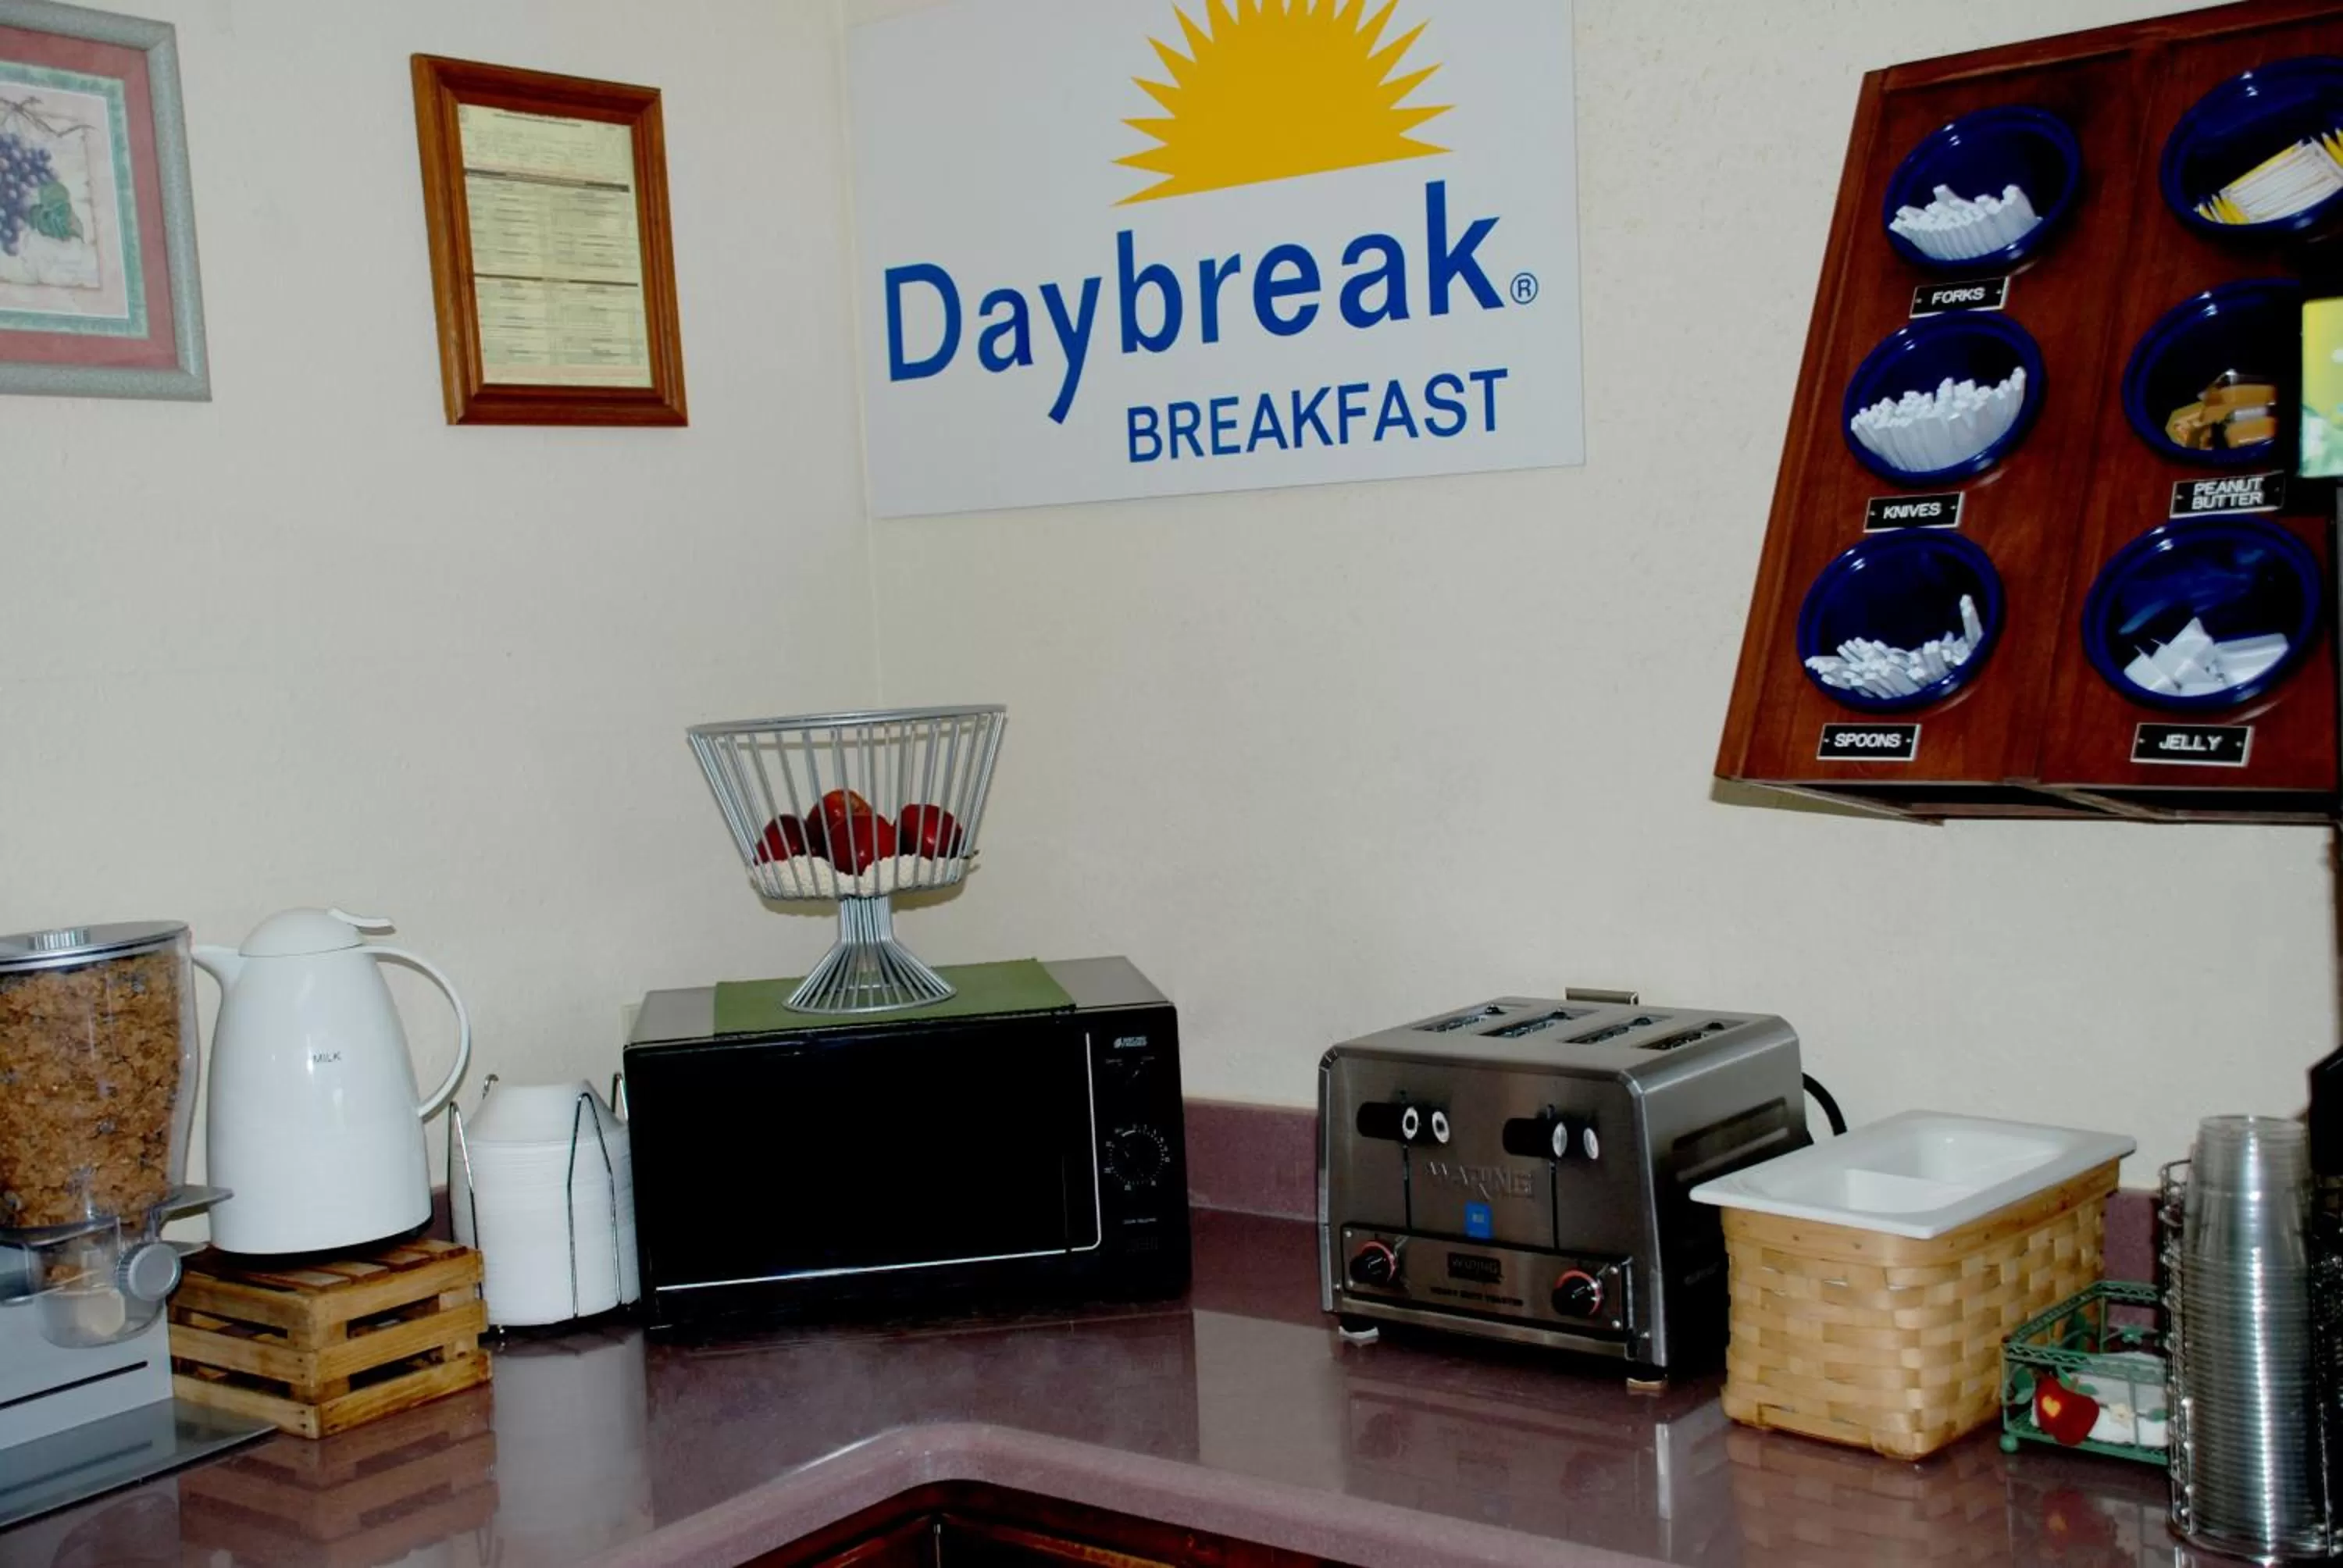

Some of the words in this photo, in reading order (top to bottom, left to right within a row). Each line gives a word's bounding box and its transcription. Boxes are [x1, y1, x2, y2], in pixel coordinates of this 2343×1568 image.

[884, 180, 1505, 425] Daybreak
[1931, 287, 1986, 305] FORKS
[1127, 368, 1509, 463] BREAKFAST
[2193, 477, 2264, 496] PEANUT
[2191, 492, 2263, 510] BUTTER
[1883, 502, 1942, 519] KNIVES
[1834, 732, 1902, 748] SPOONS
[2159, 734, 2223, 751] JELLY
[312, 1049, 342, 1063] MILK
